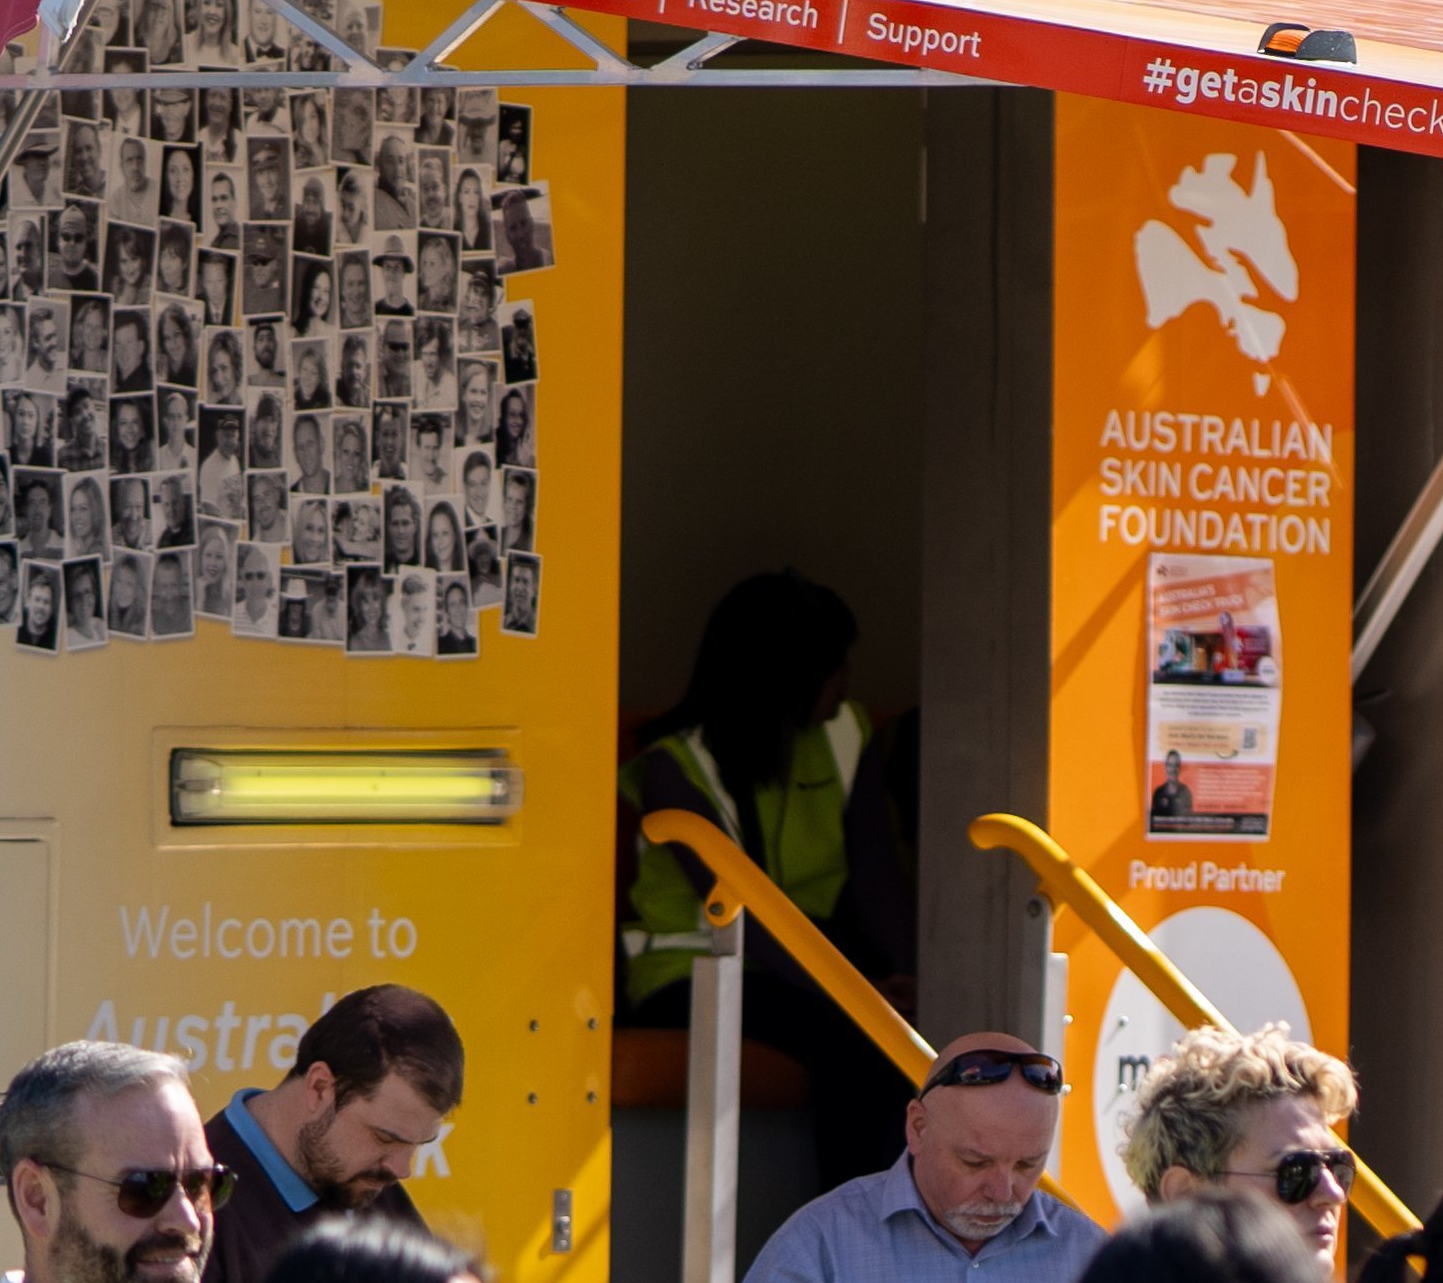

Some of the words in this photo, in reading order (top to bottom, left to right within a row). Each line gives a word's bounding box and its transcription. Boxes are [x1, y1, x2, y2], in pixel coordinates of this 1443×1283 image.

[866, 12, 982, 58] Support
[1100, 409, 1332, 463] AUSTRALIAN
[1100, 457, 1181, 498] SKIN
[1189, 463, 1330, 508] CANCER
[1099, 505, 1330, 555] FOUNDATION
[1129, 860, 1197, 890] Proud
[1200, 862, 1287, 892] Partner
[119, 902, 353, 959] Welcome
[368, 908, 417, 959] to
